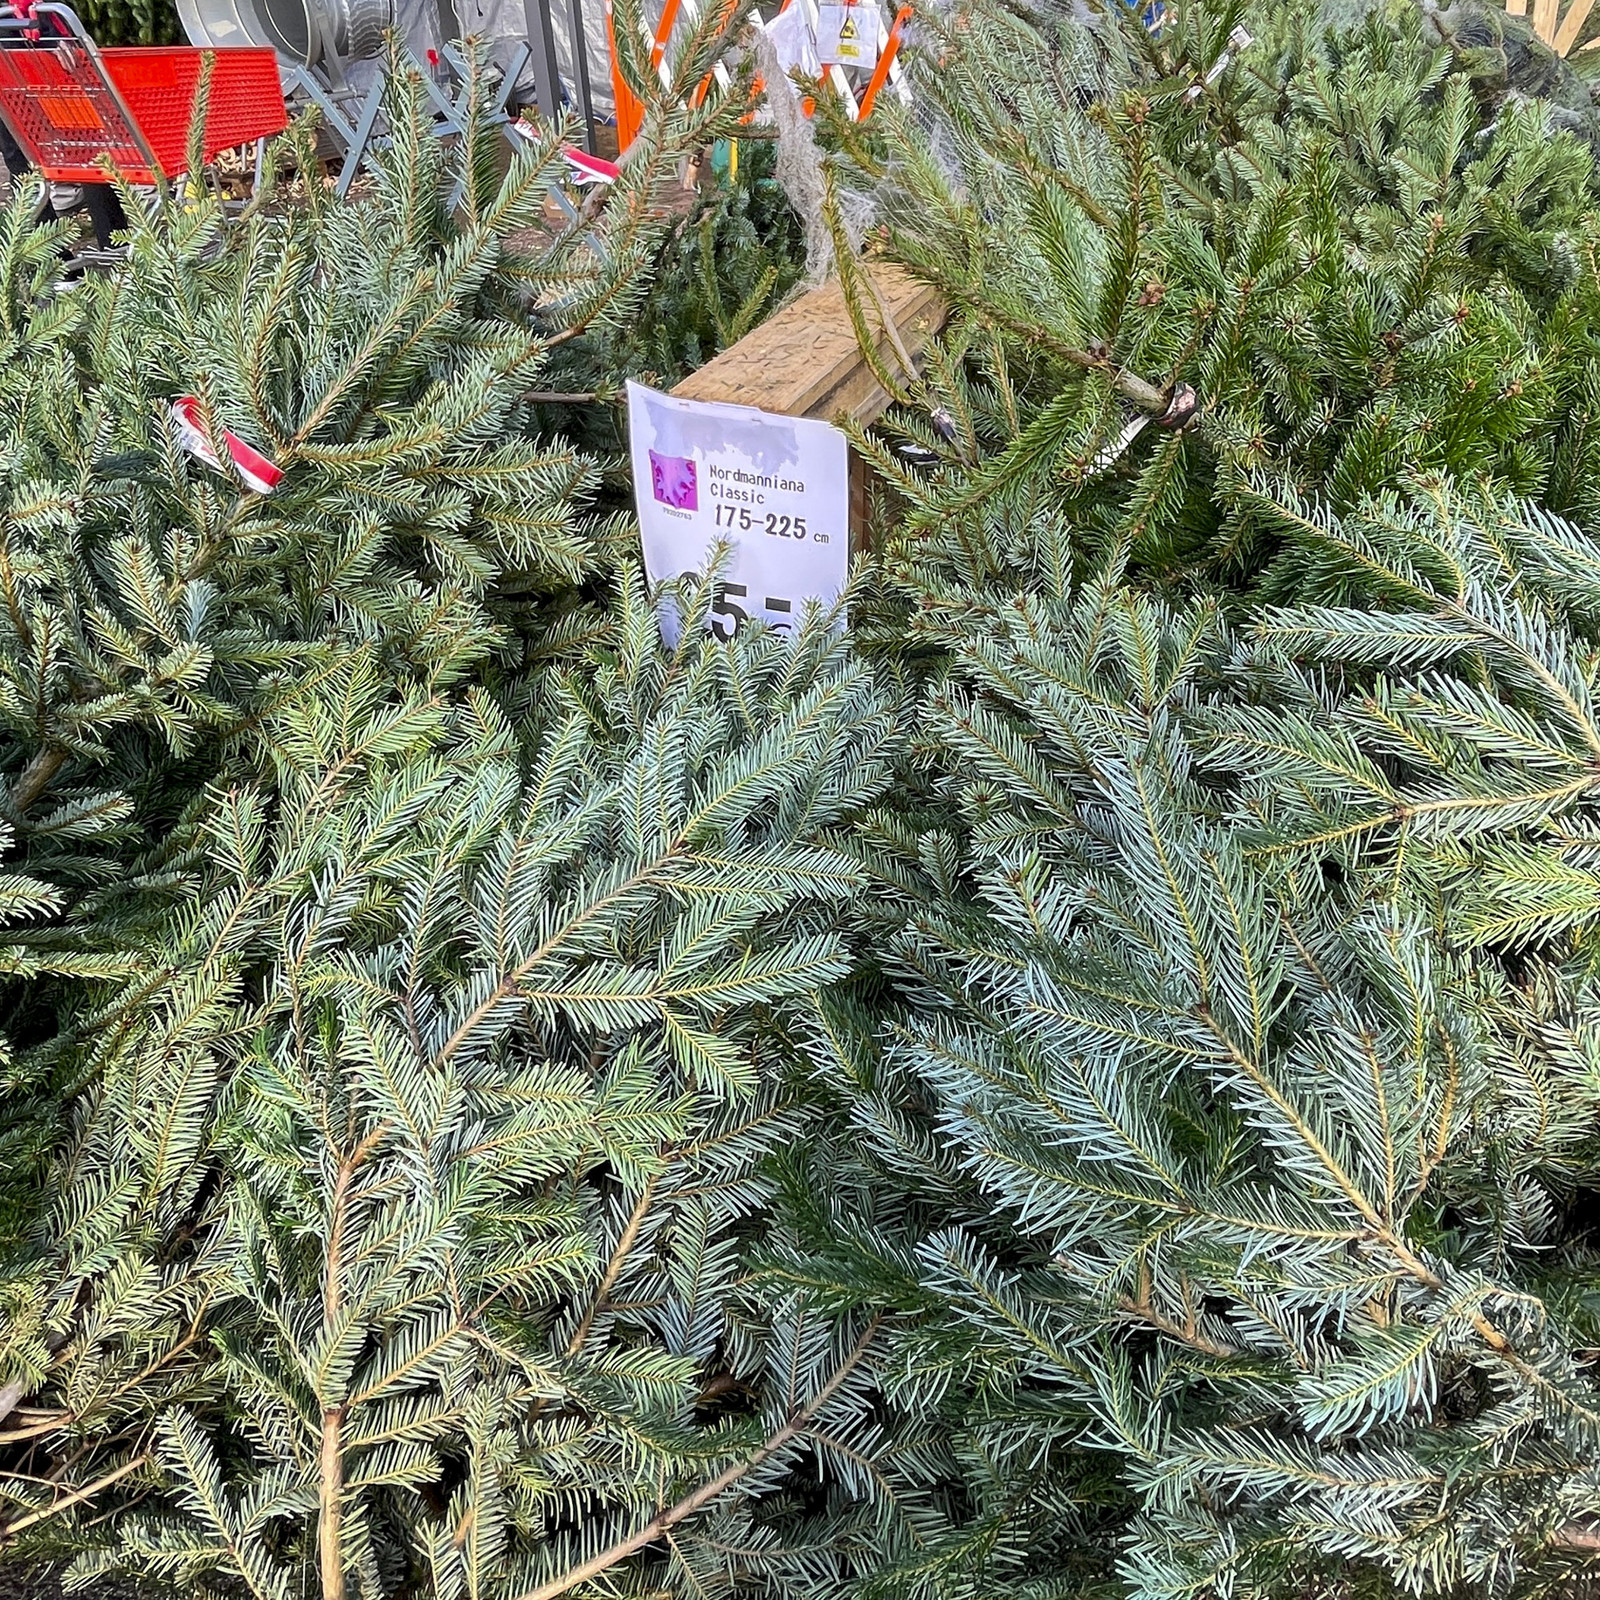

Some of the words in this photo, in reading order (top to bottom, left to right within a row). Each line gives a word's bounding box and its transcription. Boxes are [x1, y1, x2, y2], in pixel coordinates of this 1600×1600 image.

[709, 464, 805, 492] Nordmanniana
[710, 482, 765, 504] Classic
[813, 533, 830, 544] cm
